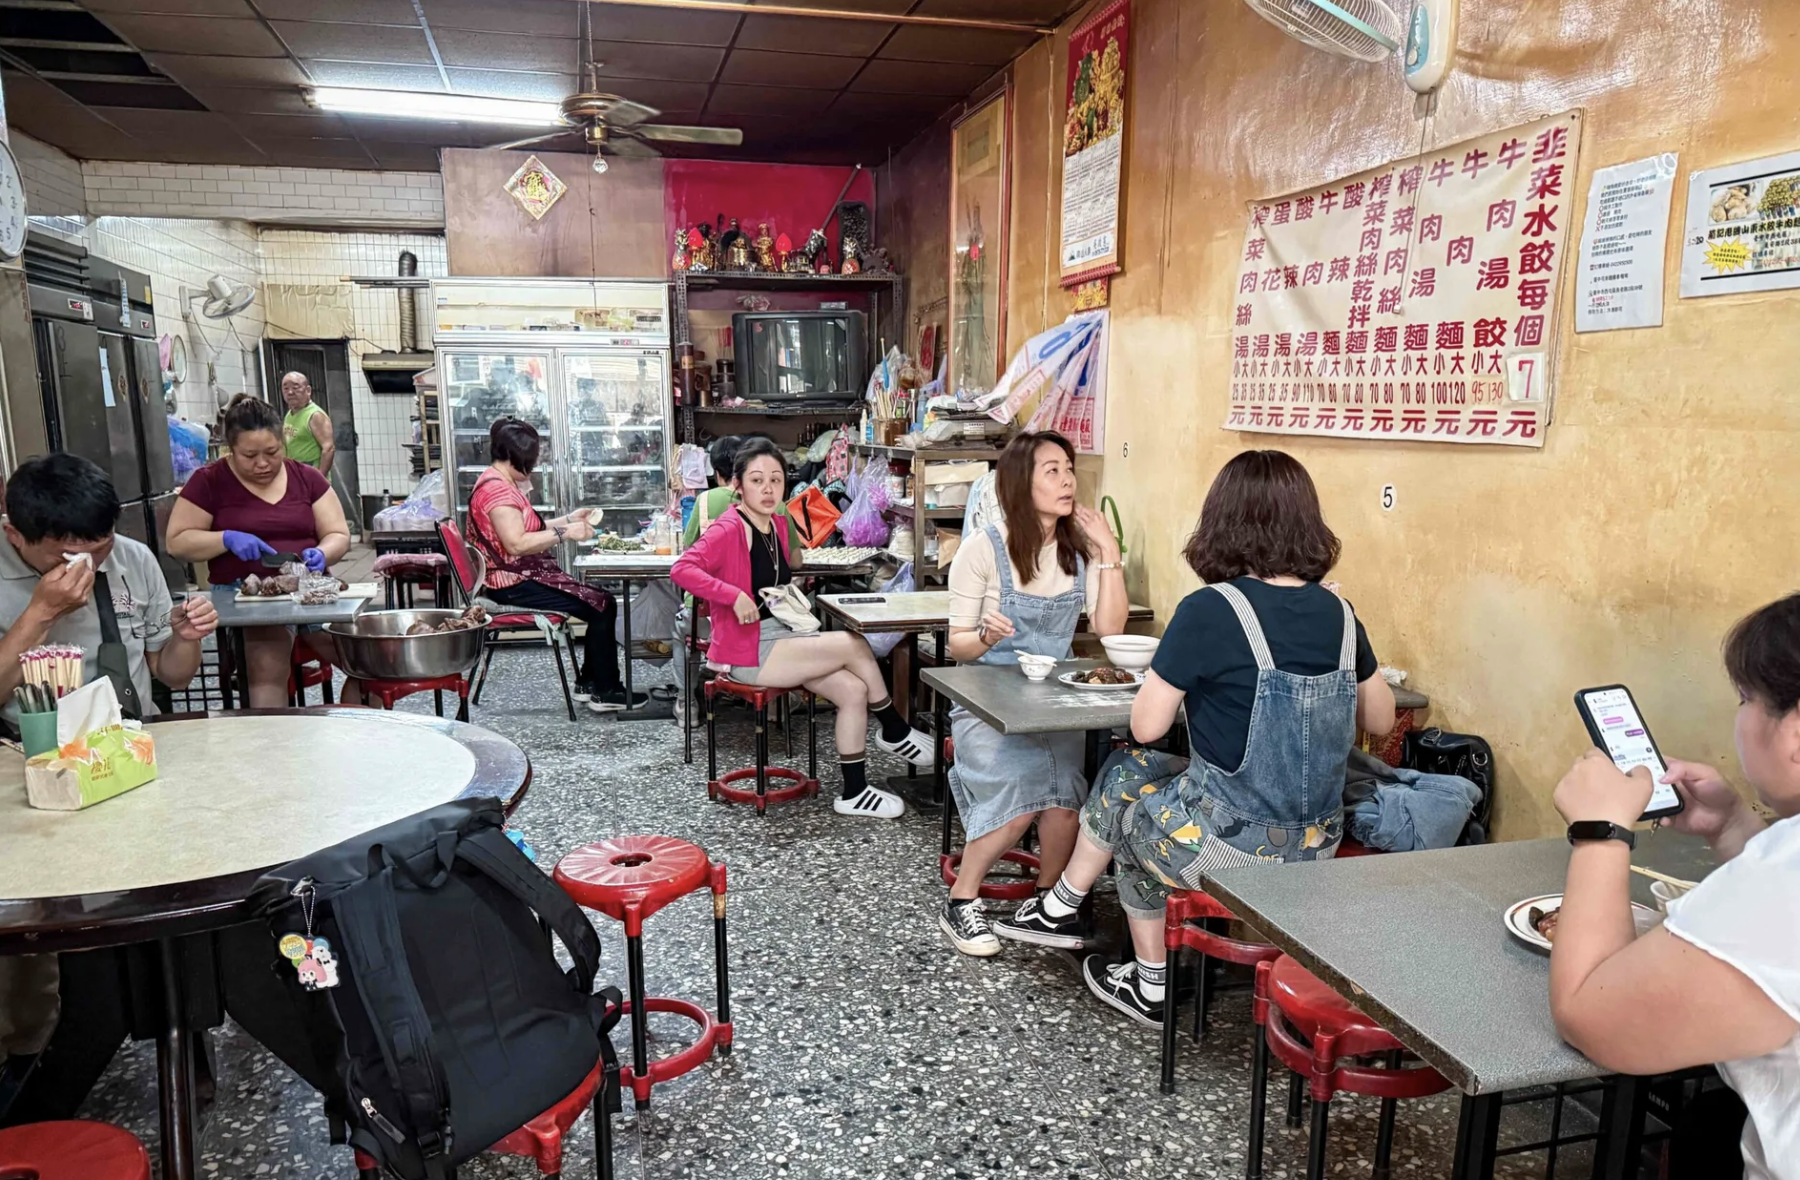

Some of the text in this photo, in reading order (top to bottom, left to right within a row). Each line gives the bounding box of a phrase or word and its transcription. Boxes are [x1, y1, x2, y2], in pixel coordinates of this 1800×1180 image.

[1518, 359, 1535, 399] 7
[1268, 383, 1276, 402] 25
[1279, 383, 1289, 402] 35
[1292, 383, 1300, 403] 90
[1317, 383, 1326, 403] 70
[1328, 383, 1338, 403] 80
[1342, 383, 1351, 403] 70
[1354, 383, 1364, 403] 80
[1369, 382, 1379, 404] 70
[1383, 382, 1394, 404] 80
[1400, 382, 1411, 404] 70
[1415, 382, 1426, 404] 80
[1471, 381, 1486, 403] 95
[1229, 405, 1246, 425] 元
[1248, 406, 1263, 426] 元
[1267, 406, 1285, 427] 元
[1288, 407, 1310, 428] 元
[1313, 408, 1337, 430] 元
[1341, 408, 1365, 431] 元
[1369, 409, 1395, 432] 元
[1400, 410, 1427, 433] 元
[1432, 410, 1461, 435] 元
[1466, 410, 1498, 436] 元
[1502, 411, 1537, 438] 元
[1122, 442, 1129, 458] 6
[1383, 486, 1393, 508] 5
